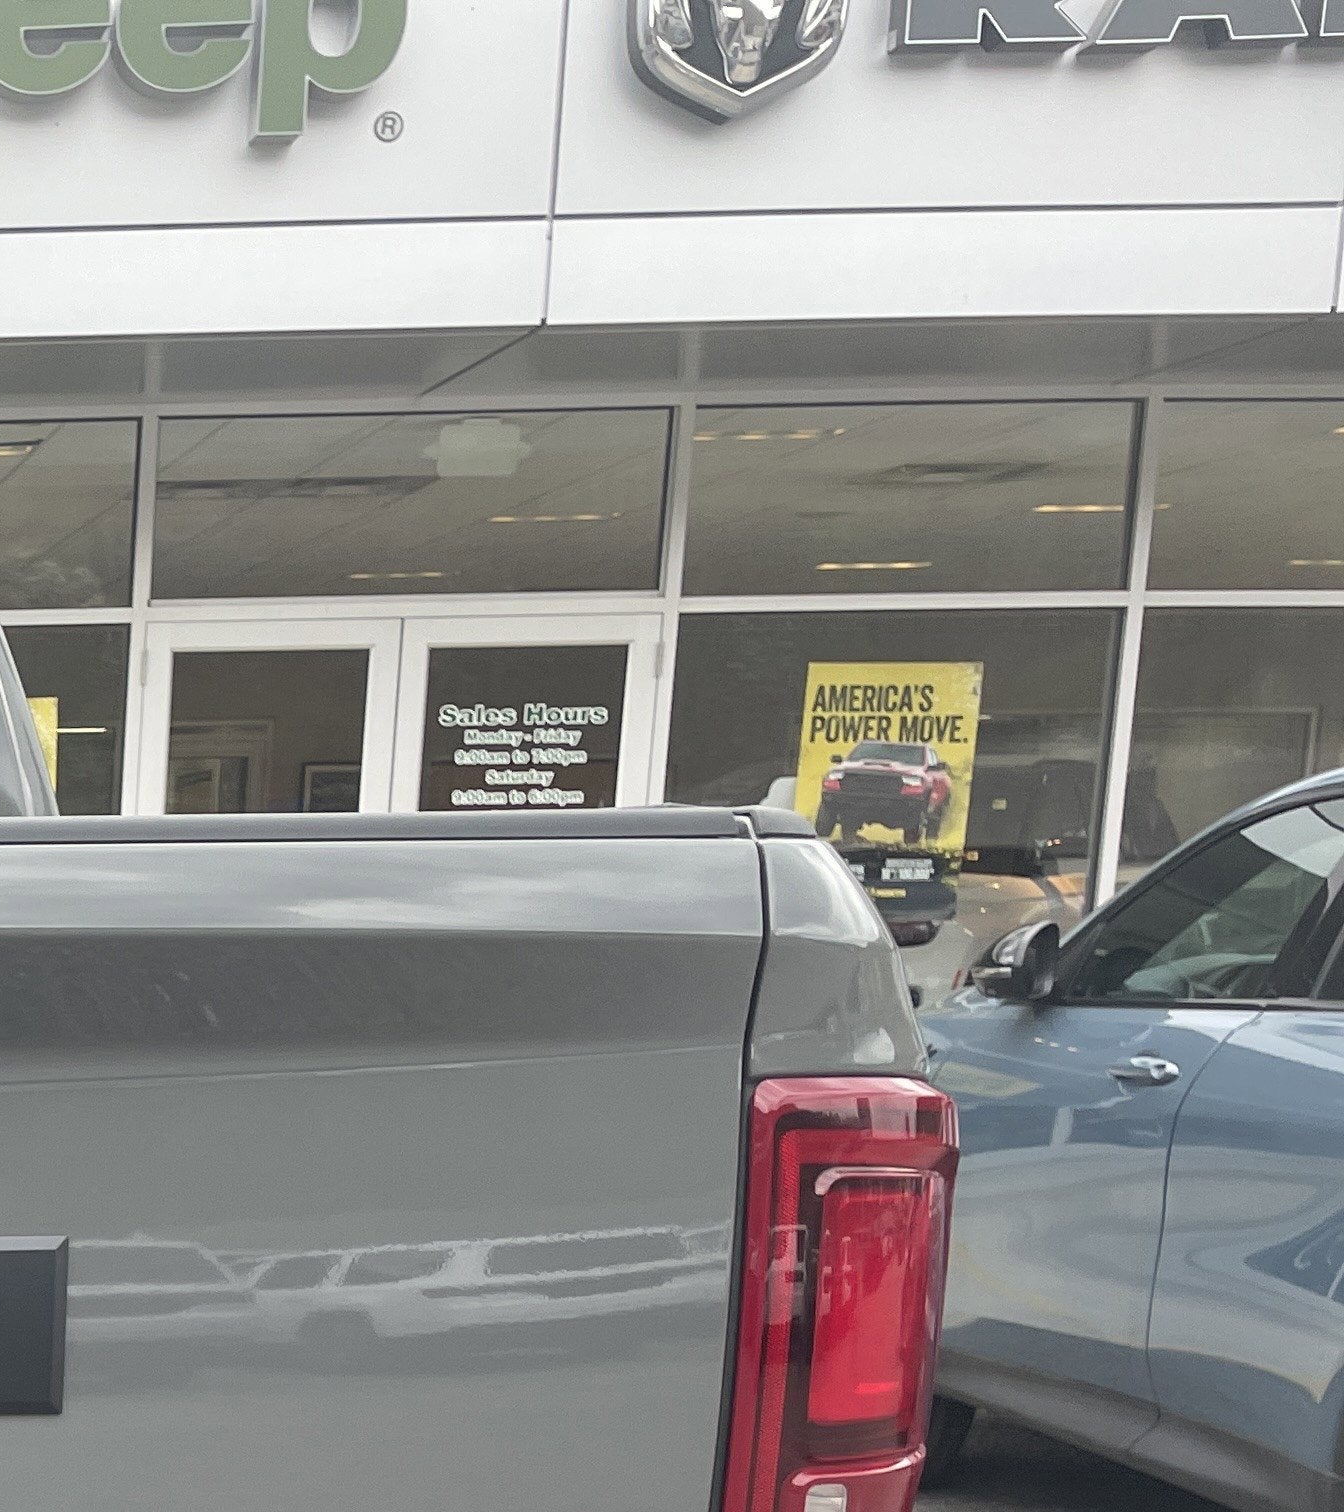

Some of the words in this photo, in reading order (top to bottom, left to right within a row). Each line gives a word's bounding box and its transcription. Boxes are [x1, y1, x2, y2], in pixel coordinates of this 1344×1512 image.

[811, 684, 935, 713] AMERICA'S
[438, 703, 518, 727] Sales
[523, 702, 609, 726] Hours
[463, 729, 524, 748] Monday
[533, 728, 583, 747] Friday
[808, 715, 892, 744] POWER
[898, 714, 969, 744] MOVE.
[511, 748, 531, 765] to
[485, 768, 555, 787] Saturday
[508, 788, 527, 806] to
